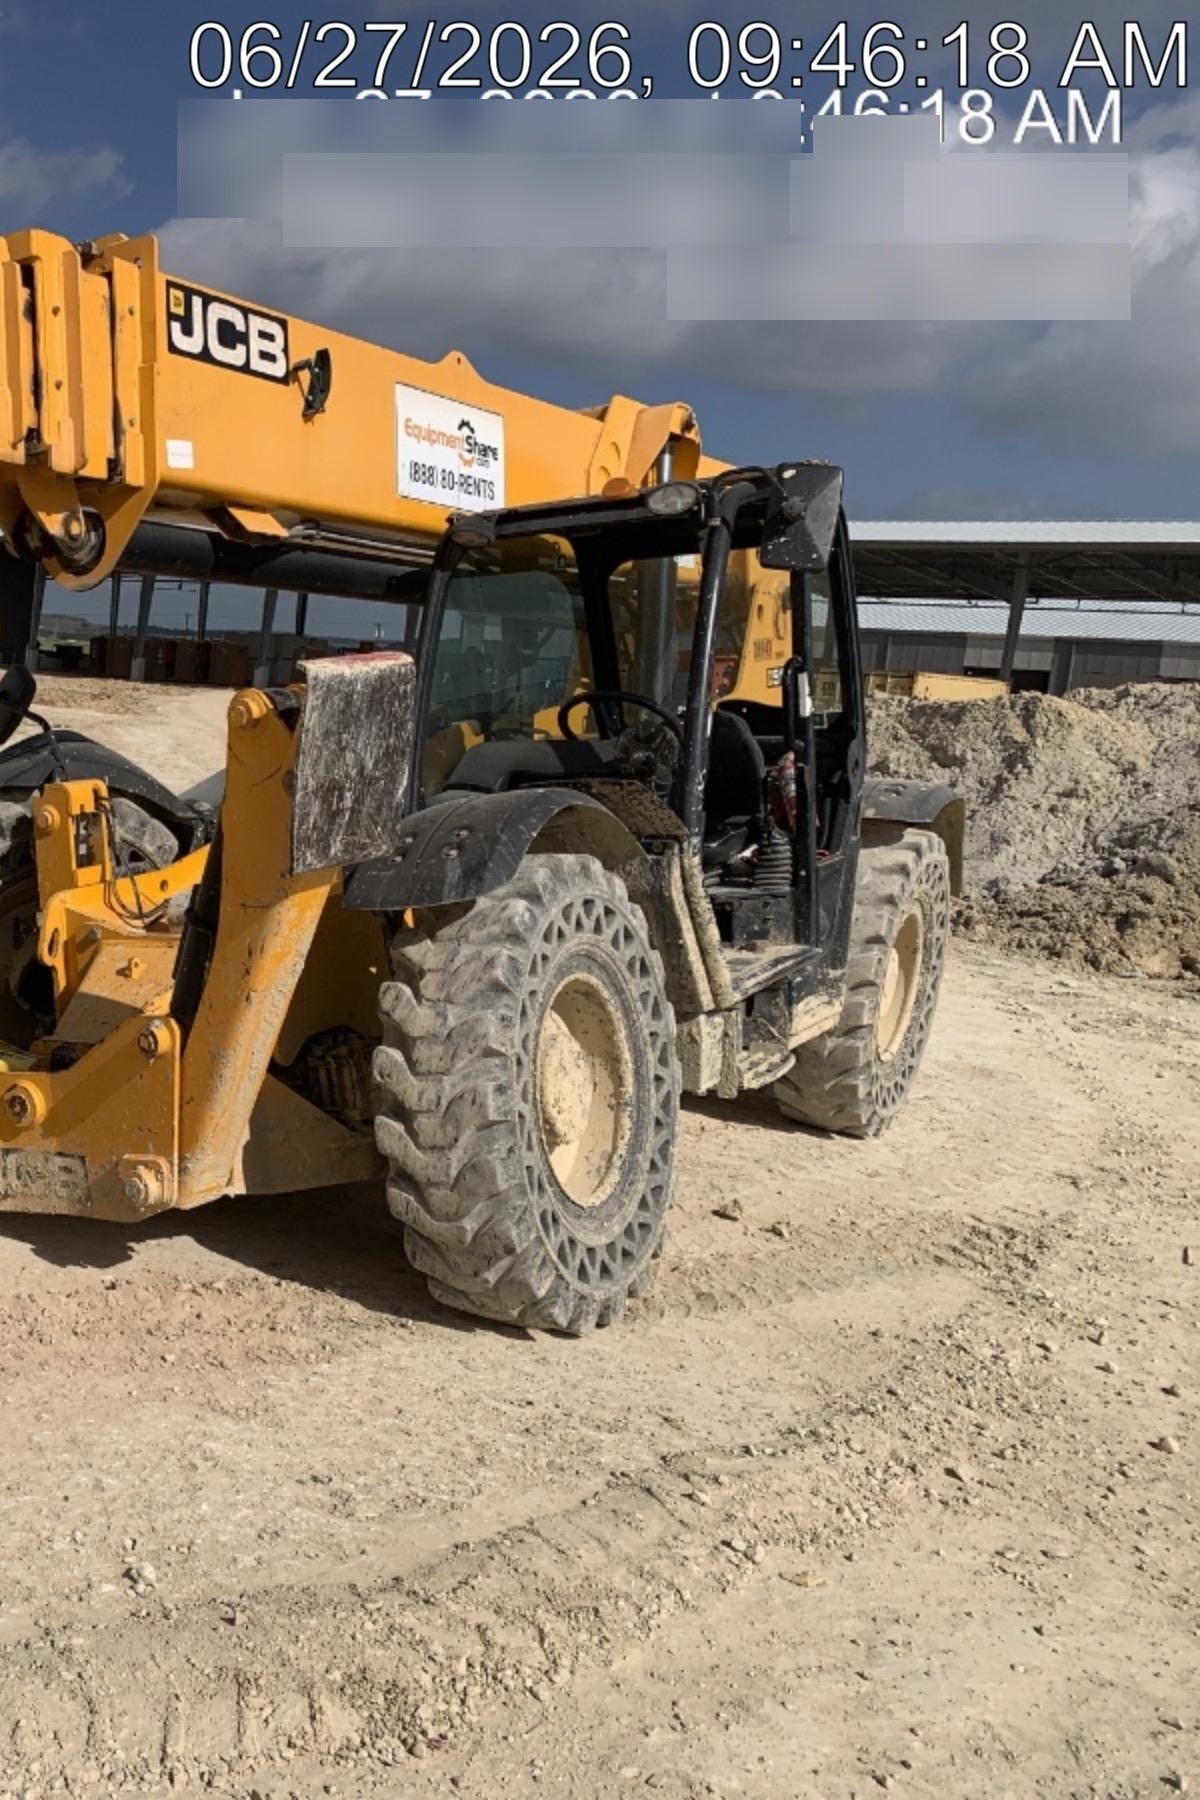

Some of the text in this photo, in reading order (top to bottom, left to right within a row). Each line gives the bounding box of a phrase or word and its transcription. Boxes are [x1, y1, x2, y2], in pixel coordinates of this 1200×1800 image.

[170, 294, 287, 379] JCB
[409, 460, 495, 501] (888) 80-RENTS
